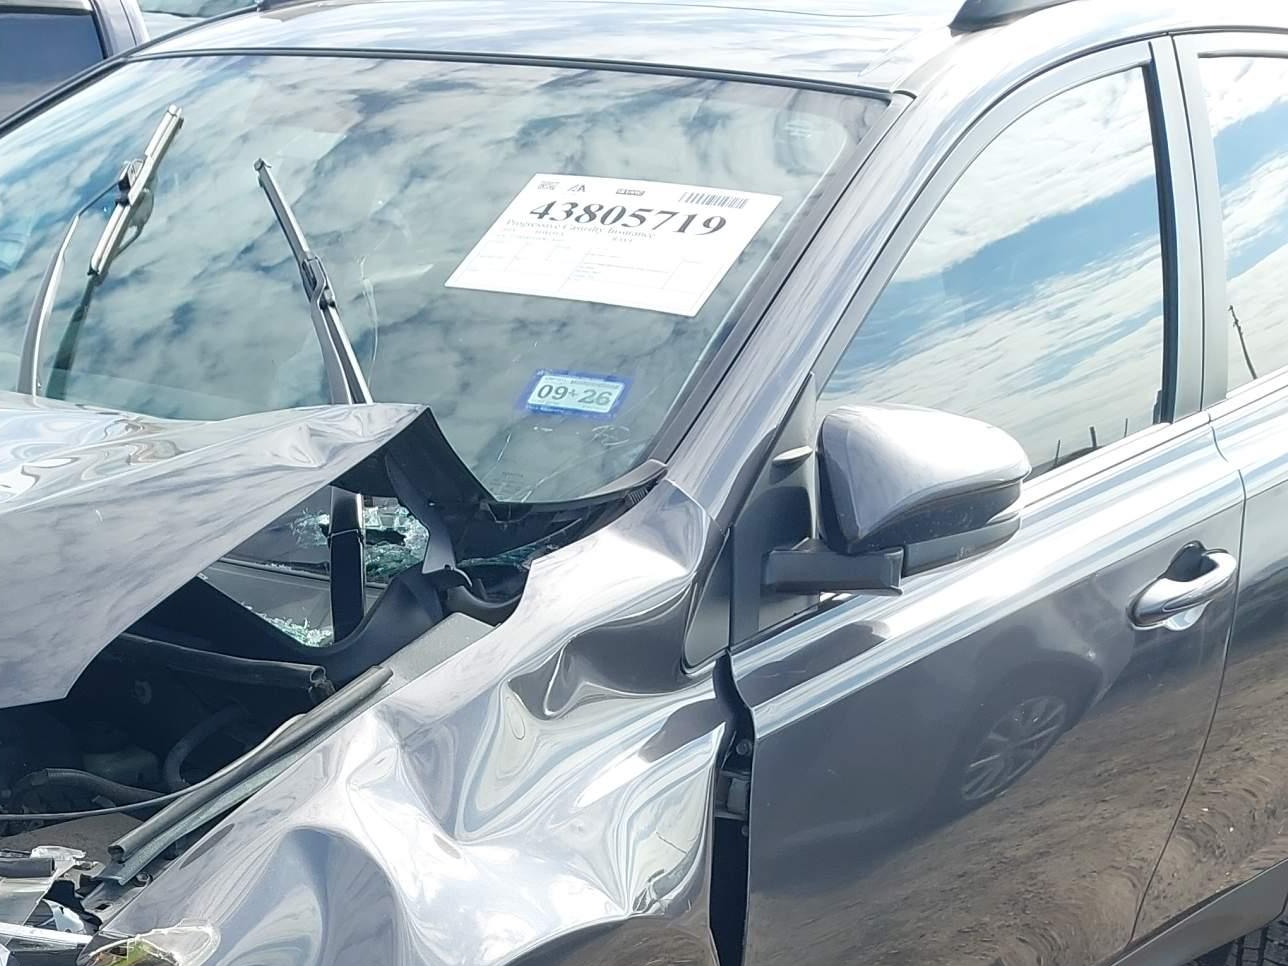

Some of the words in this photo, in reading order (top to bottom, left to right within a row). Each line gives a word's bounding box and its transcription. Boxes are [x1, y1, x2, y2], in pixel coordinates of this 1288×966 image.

[530, 200, 727, 236] 43805719
[537, 385, 569, 400] 09
[578, 389, 613, 406] 26
